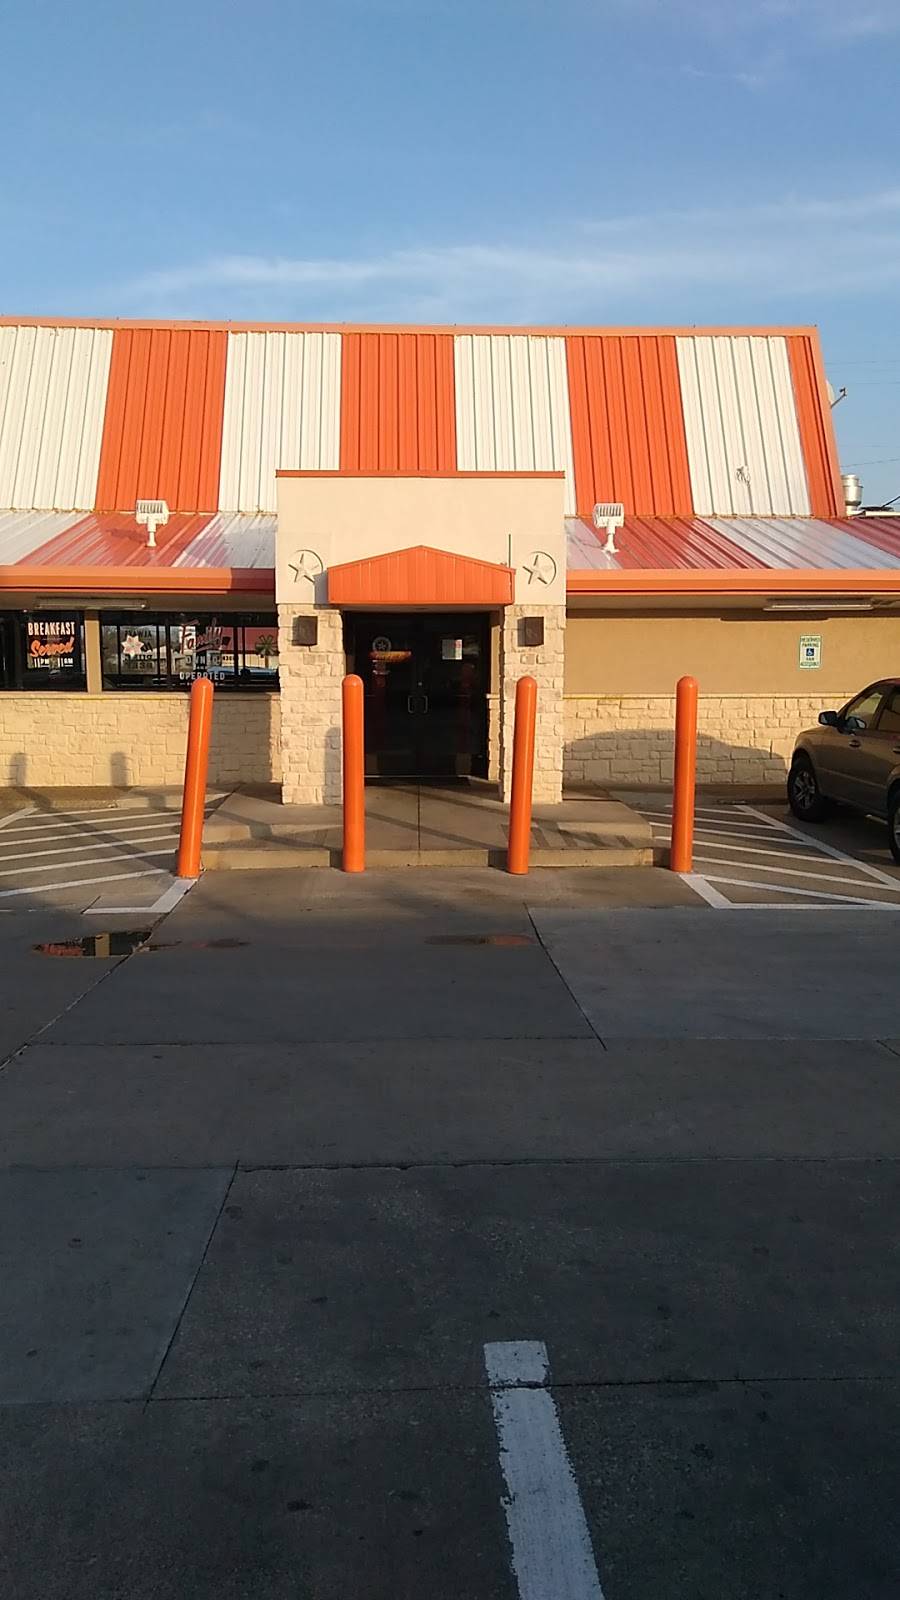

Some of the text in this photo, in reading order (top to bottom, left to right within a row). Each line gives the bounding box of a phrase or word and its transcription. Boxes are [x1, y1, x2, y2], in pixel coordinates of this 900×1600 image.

[28, 622, 75, 635] BREAKFAST
[180, 617, 224, 653] Family
[30, 636, 75, 657] Served
[34, 657, 74, 668] 11PM 11AM
[185, 656, 219, 665] OWND
[179, 671, 225, 680] OPERATED
